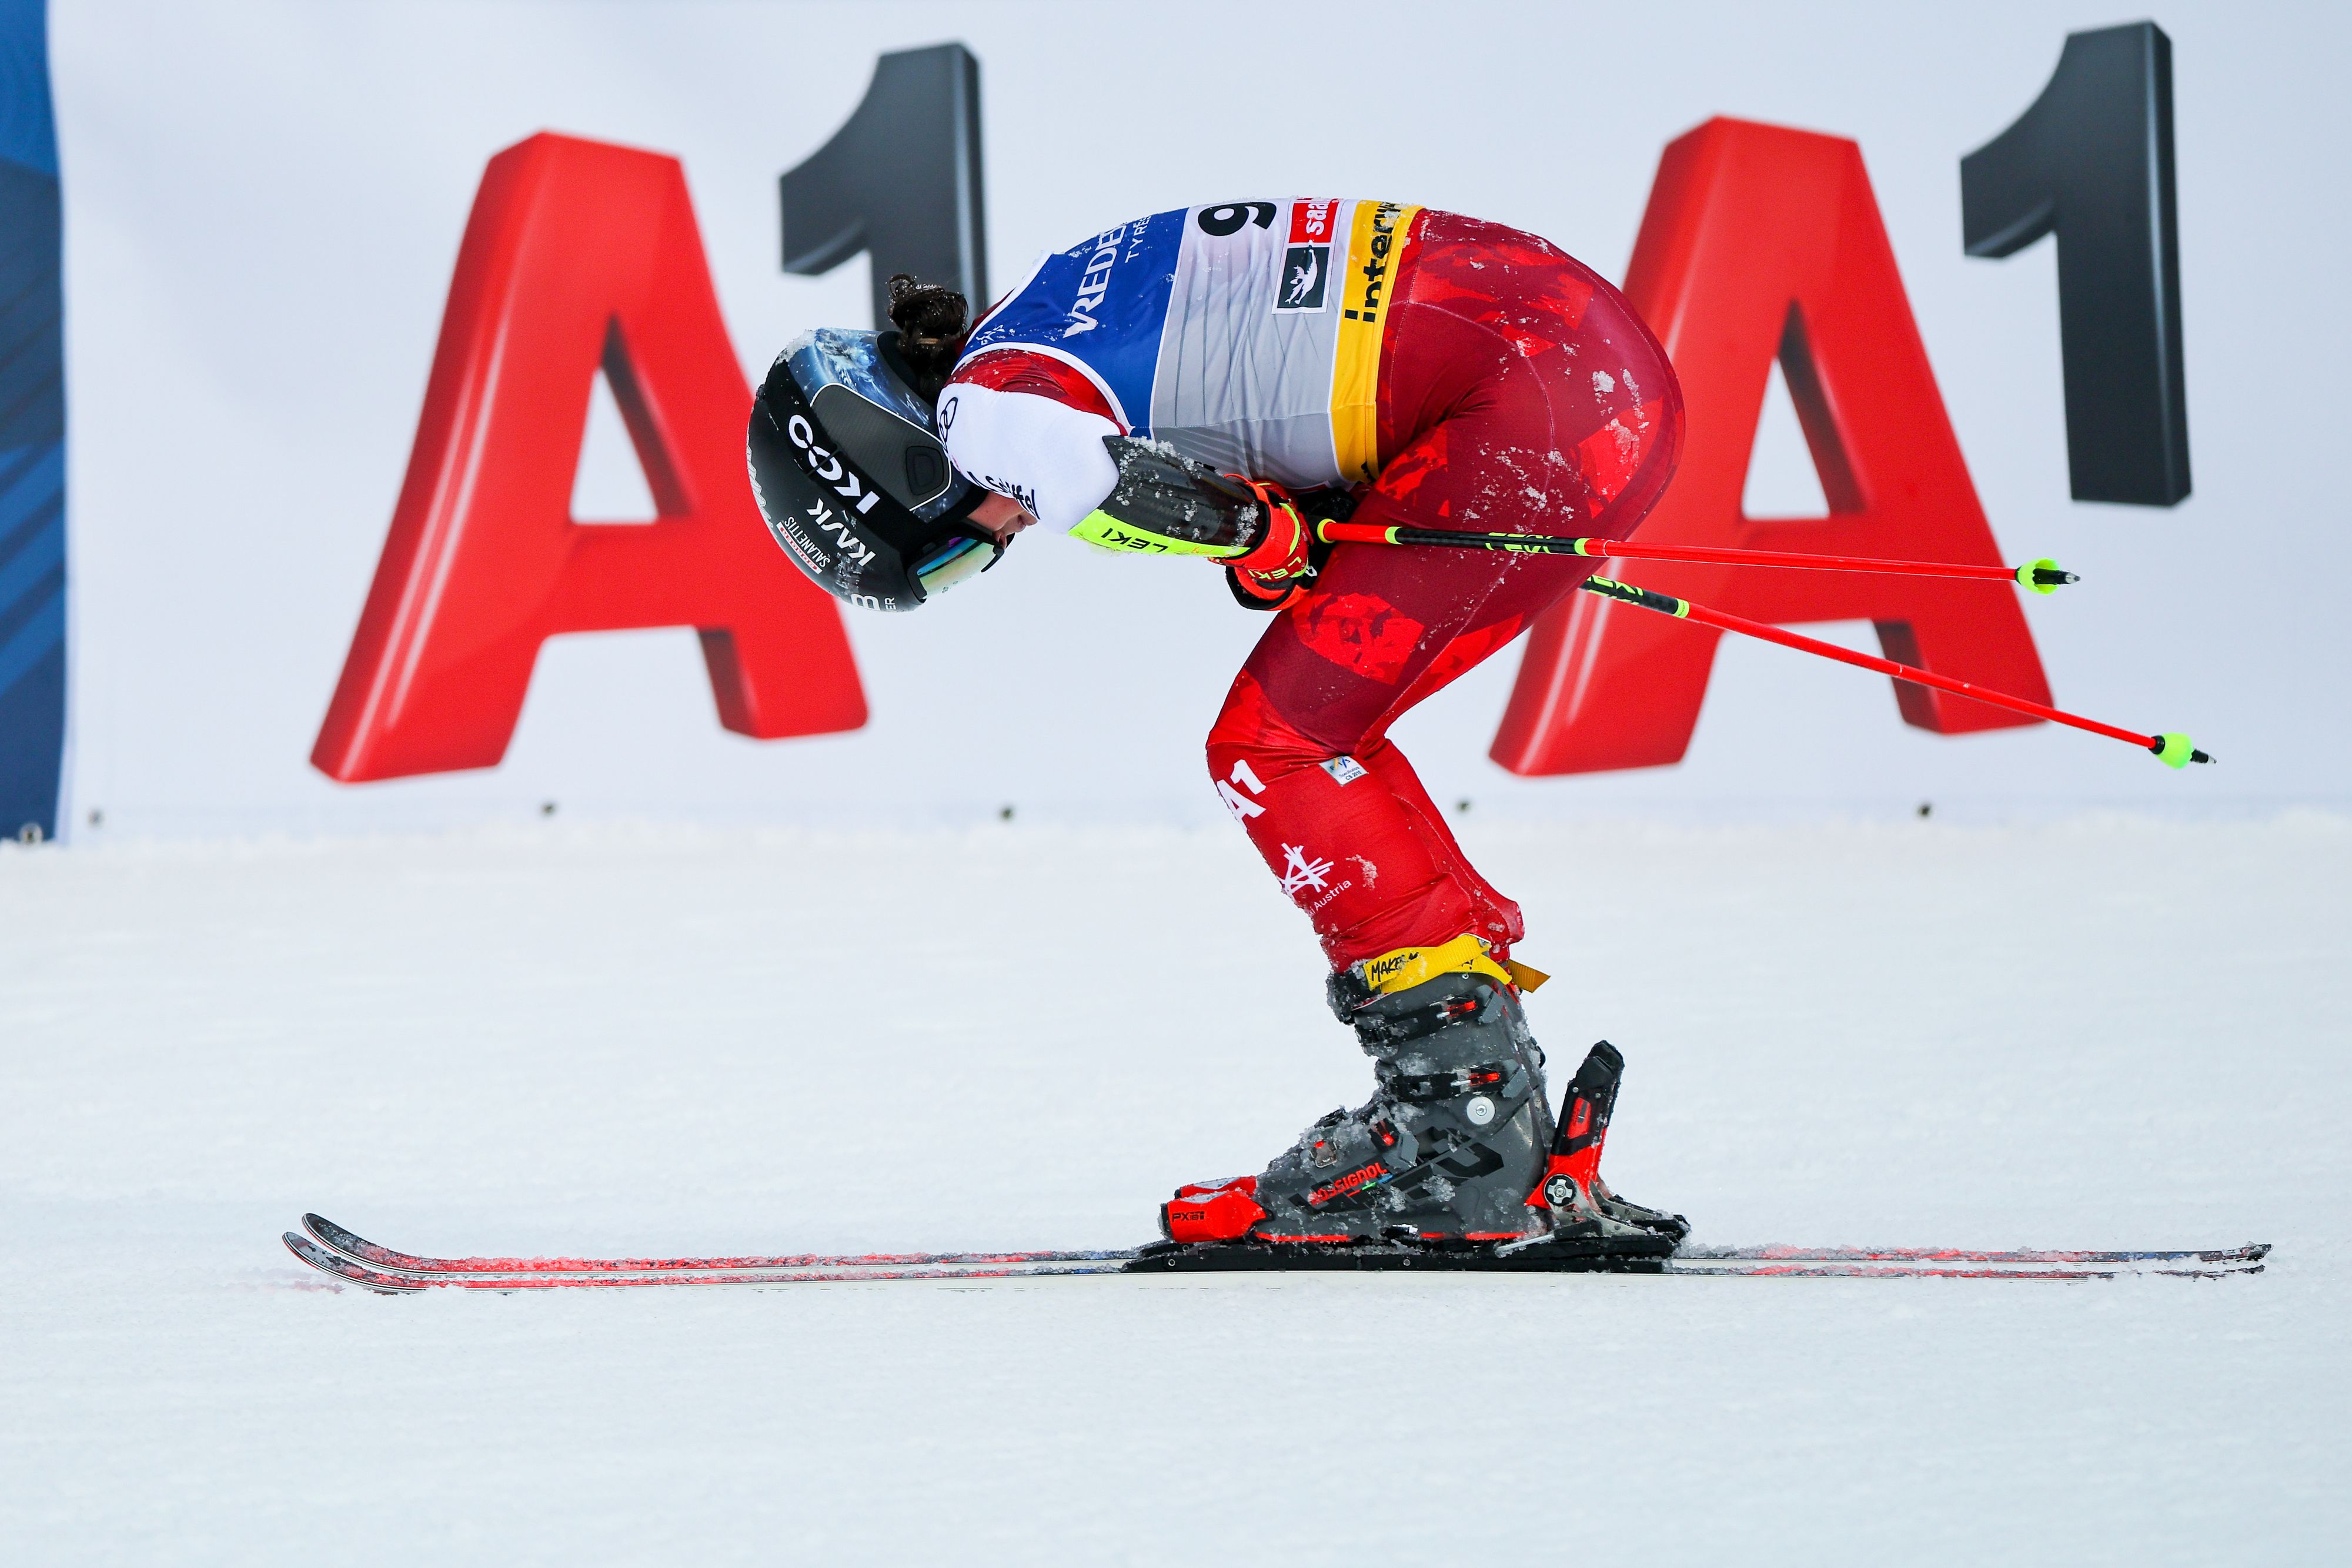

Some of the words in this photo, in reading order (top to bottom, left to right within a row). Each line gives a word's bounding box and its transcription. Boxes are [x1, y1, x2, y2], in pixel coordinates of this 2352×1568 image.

[1488, 19, 2192, 779] A1
[784, 516, 831, 567] SALANETTIS
[806, 497, 876, 567] KASK
[1101, 527, 1168, 553] LEKI
[1248, 556, 1302, 580] LEKI
[1314, 880, 1352, 911] Austria
